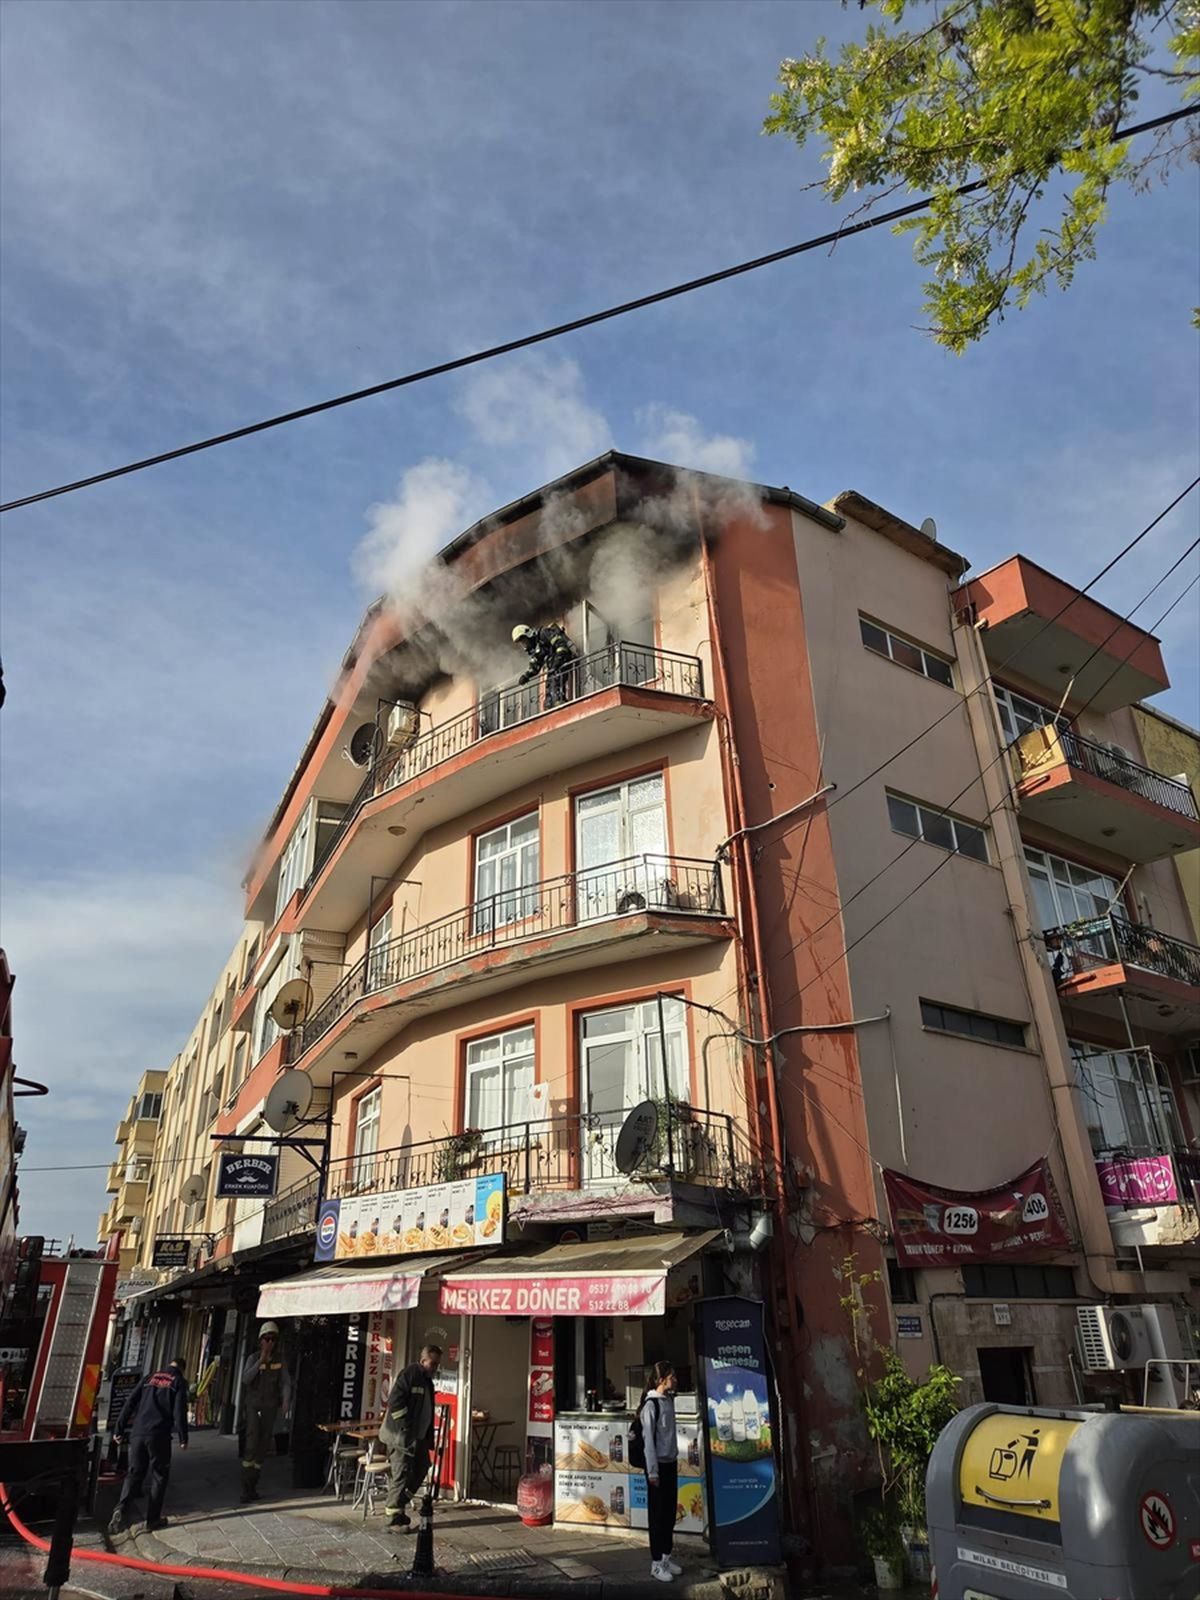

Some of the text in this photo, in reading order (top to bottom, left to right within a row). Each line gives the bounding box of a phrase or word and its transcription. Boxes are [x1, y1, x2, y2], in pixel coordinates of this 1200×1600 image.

[225, 1159, 272, 1174] BERBER
[443, 1282, 580, 1310] MERKEZ DÖNER
[588, 1300, 604, 1310] 512
